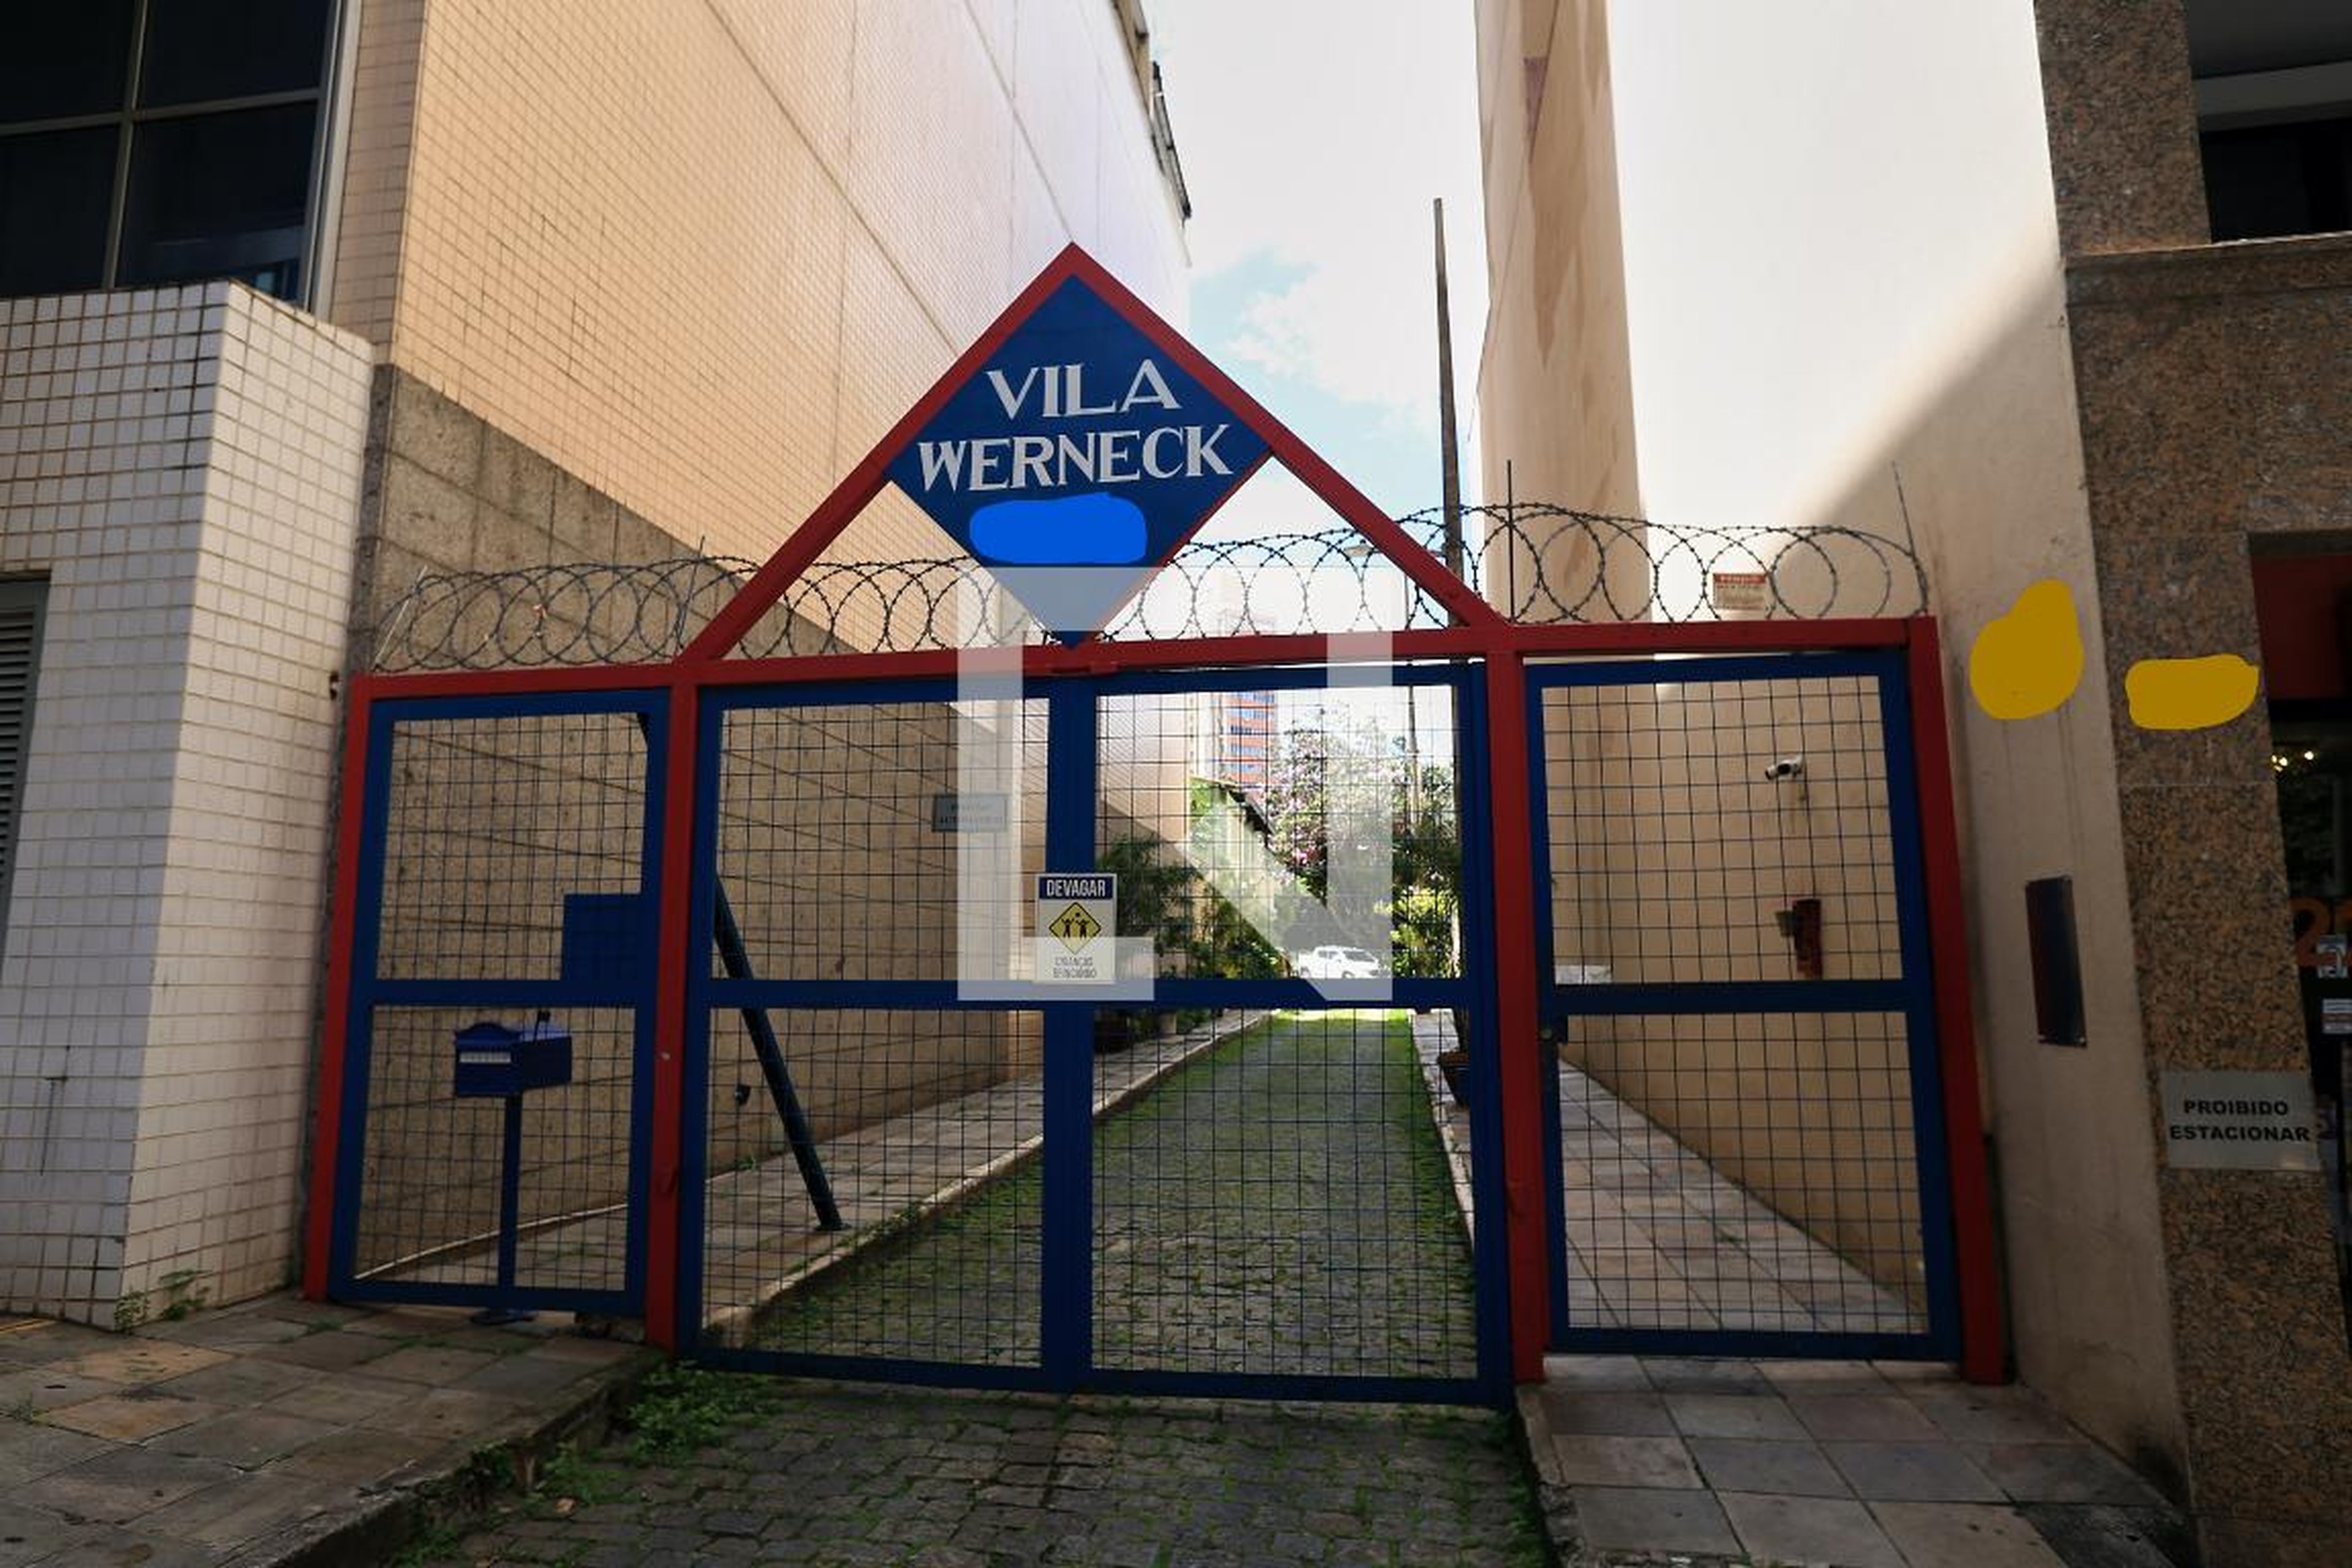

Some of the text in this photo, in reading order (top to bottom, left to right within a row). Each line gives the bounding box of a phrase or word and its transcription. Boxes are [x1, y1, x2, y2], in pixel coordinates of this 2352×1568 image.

[985, 358, 1182, 420] VILA
[918, 423, 1234, 492] WERNECK
[1046, 879, 1106, 897] DEVAGAR
[2183, 1099, 2290, 1117] PROIBIDO
[2169, 1125, 2312, 1142] ESTACIONAR
